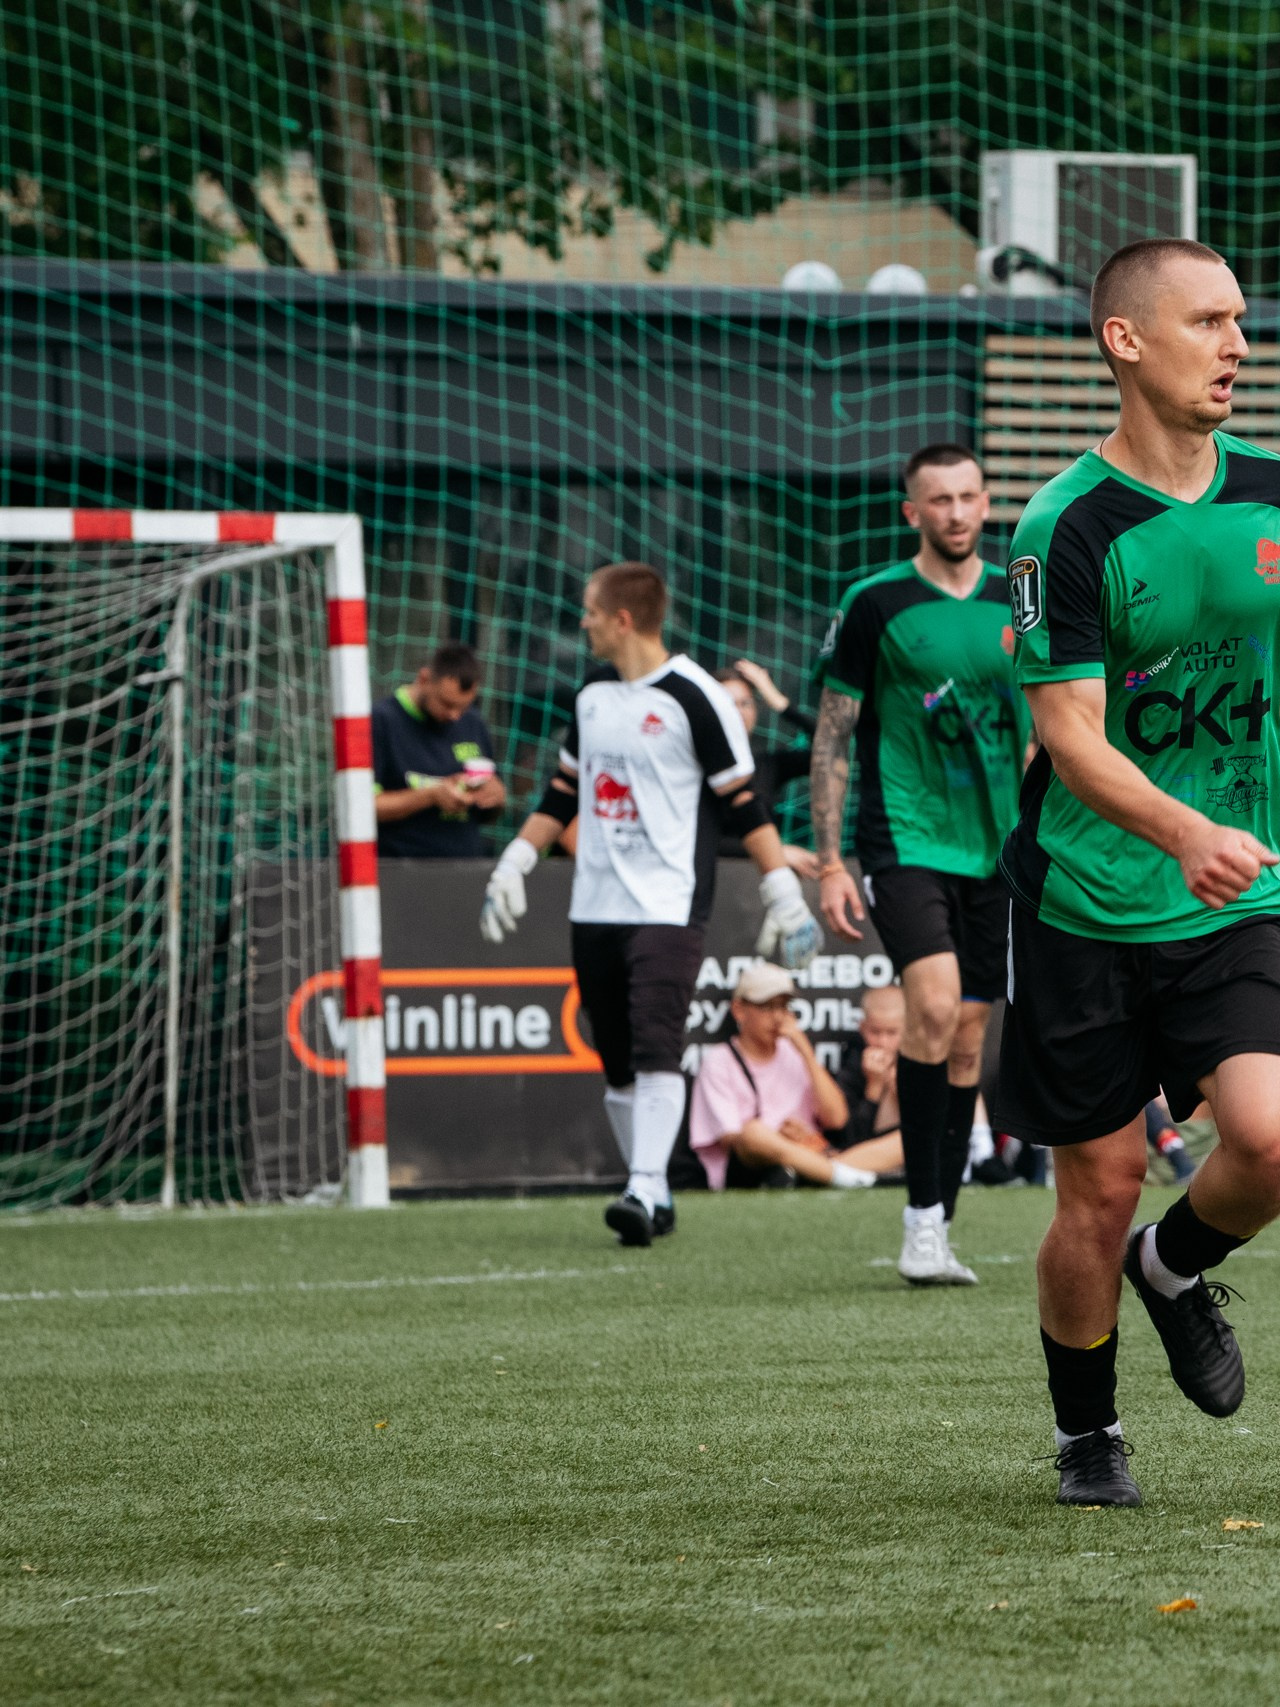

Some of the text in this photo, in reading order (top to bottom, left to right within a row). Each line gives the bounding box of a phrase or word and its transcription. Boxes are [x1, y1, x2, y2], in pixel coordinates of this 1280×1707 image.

[1122, 593, 1161, 611] DEMIX
[1181, 637, 1243, 658] VOLAT
[1146, 655, 1173, 677] ТОЧКА
[1183, 655, 1235, 675] AUTO
